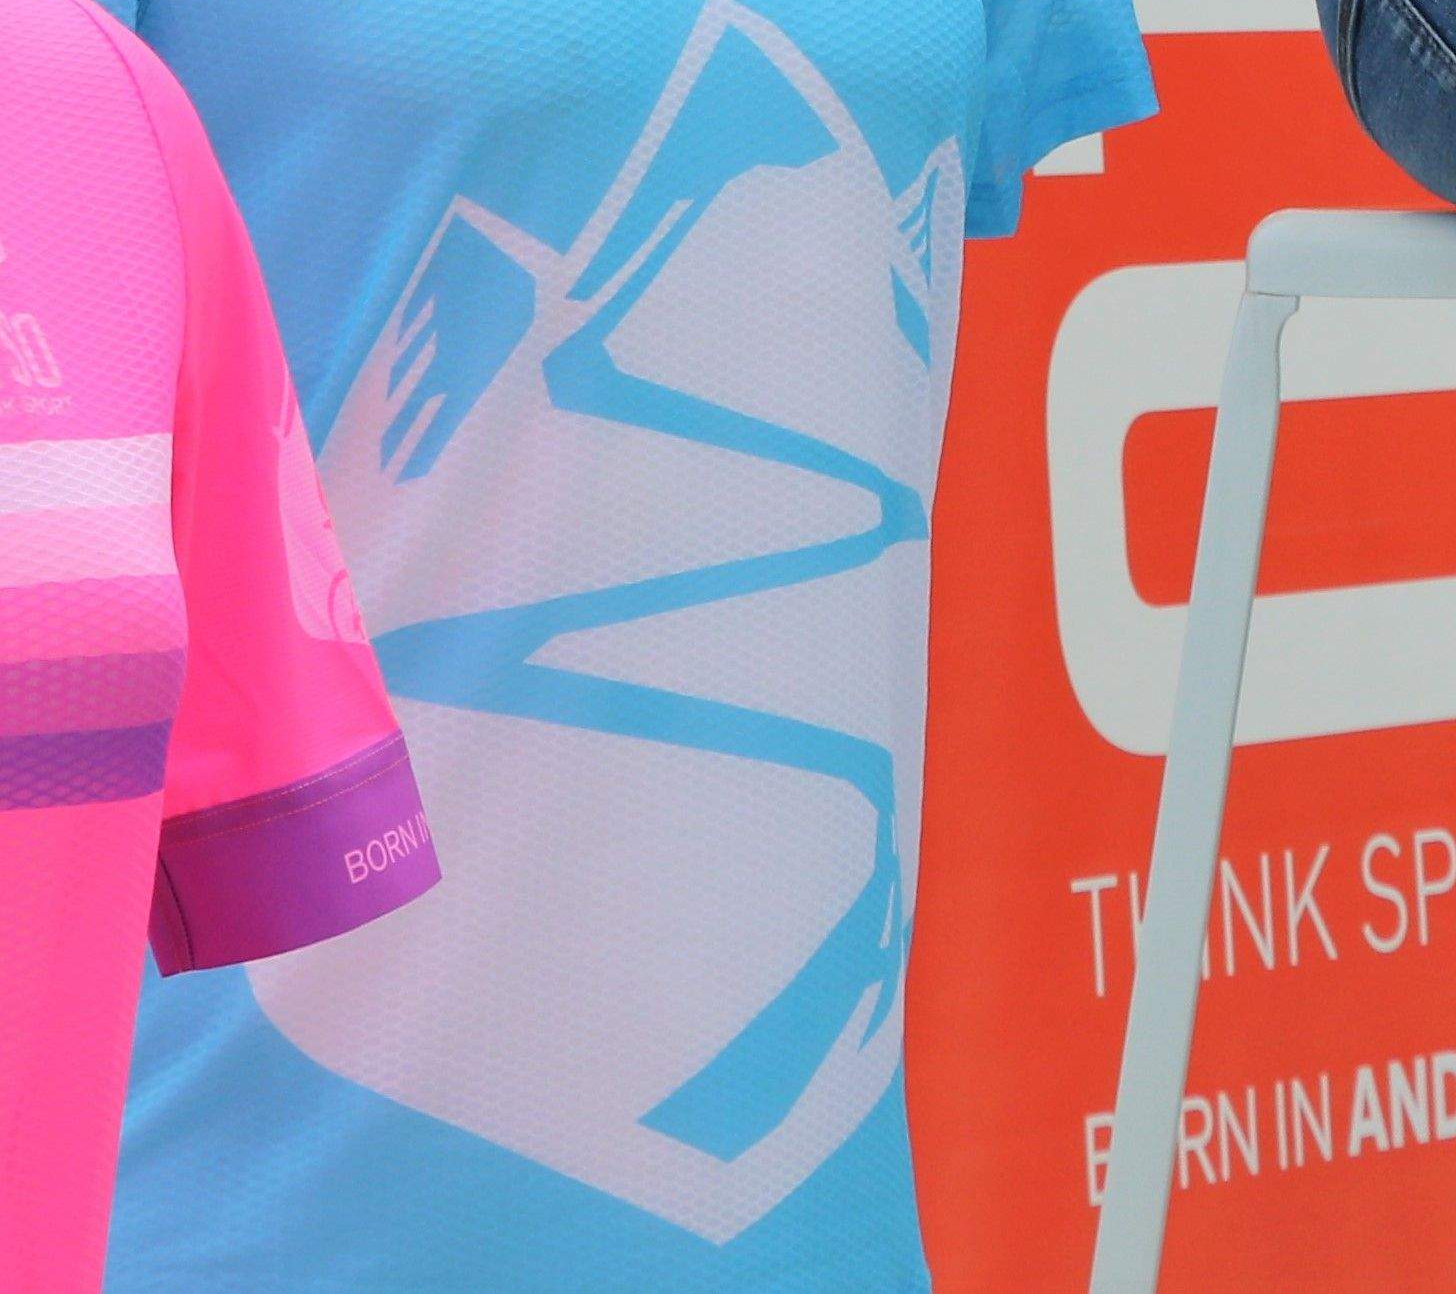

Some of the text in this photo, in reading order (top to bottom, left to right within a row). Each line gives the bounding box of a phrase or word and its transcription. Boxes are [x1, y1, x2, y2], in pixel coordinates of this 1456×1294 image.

[345, 819, 419, 884] BORN
[1070, 845, 1337, 998] TNK
[1084, 1083, 1261, 1208] BRN
[1275, 1074, 1335, 1171] IN
